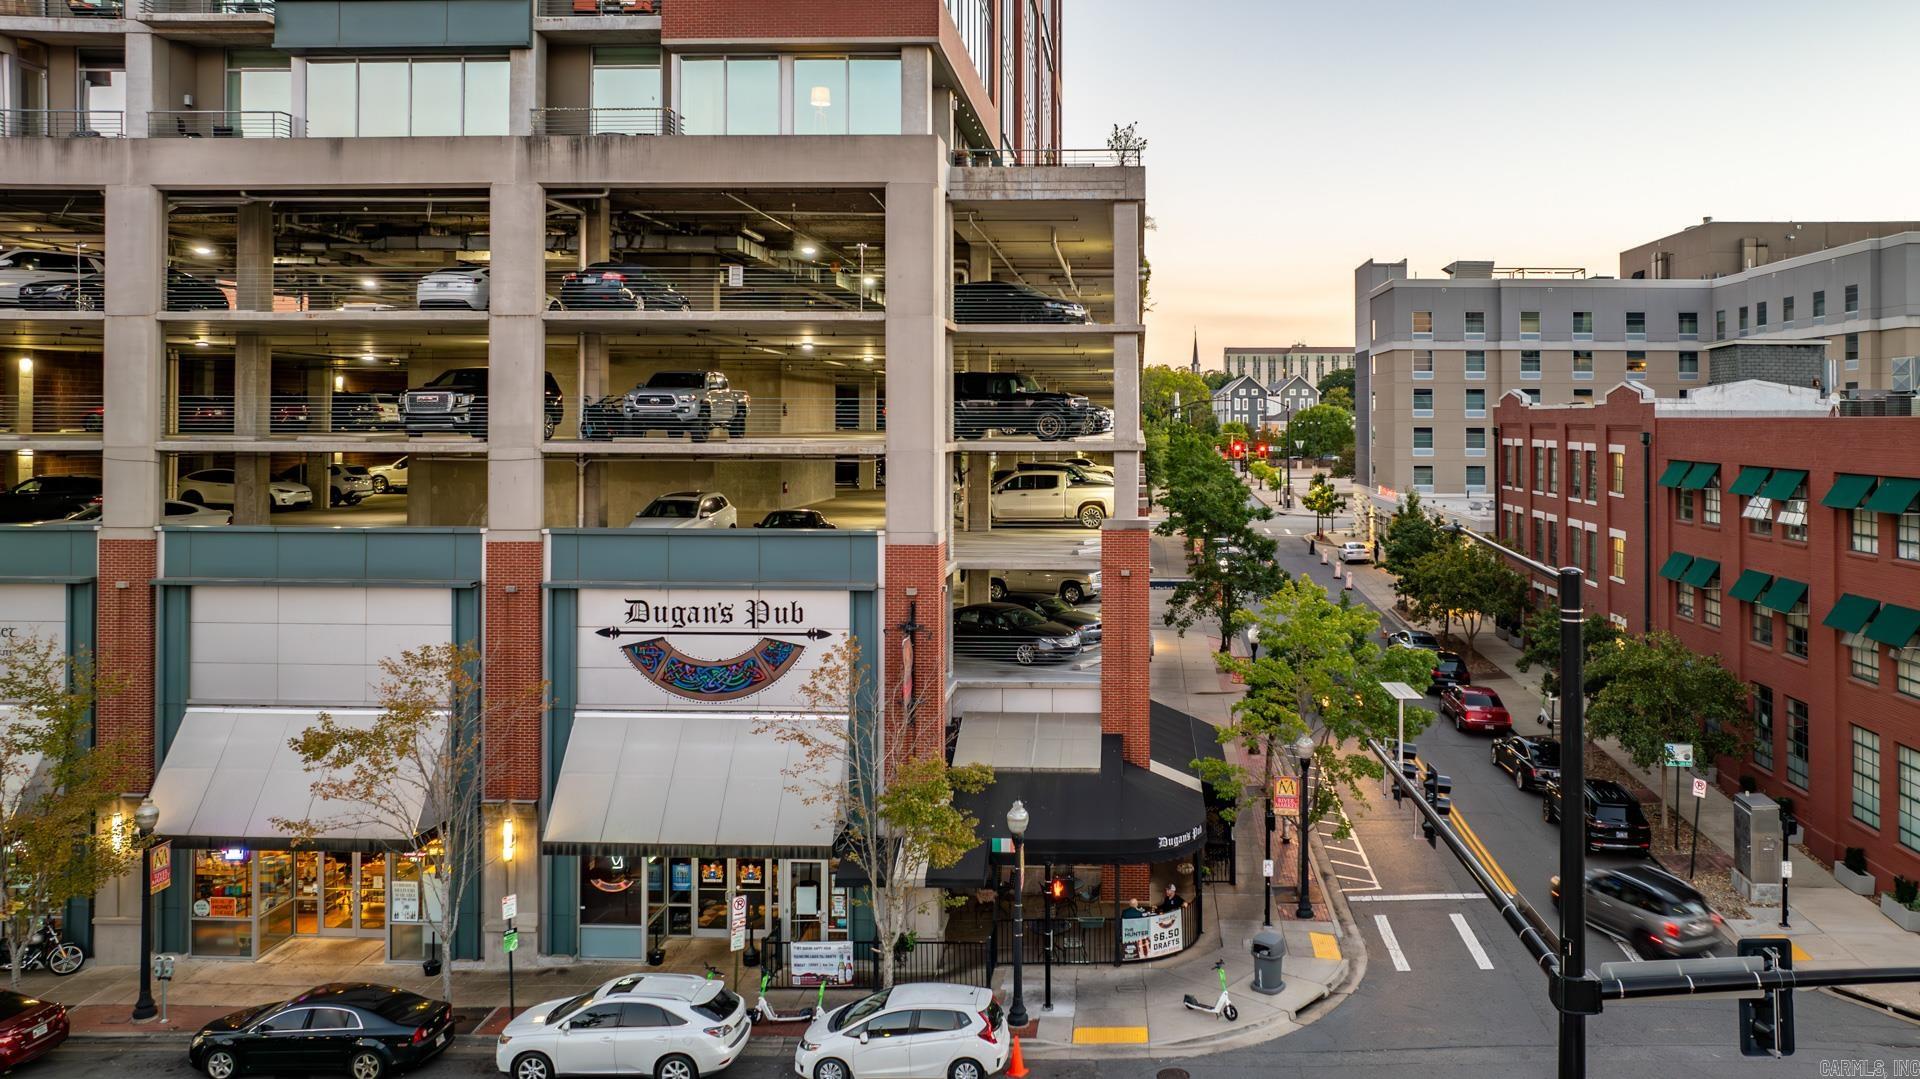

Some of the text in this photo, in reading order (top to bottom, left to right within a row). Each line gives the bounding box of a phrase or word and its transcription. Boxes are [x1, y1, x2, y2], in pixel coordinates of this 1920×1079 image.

[624, 599, 804, 628] Dugan's Pub
[1153, 928, 1180, 941] $6.50
[1153, 938, 1180, 951] DRAFTS
